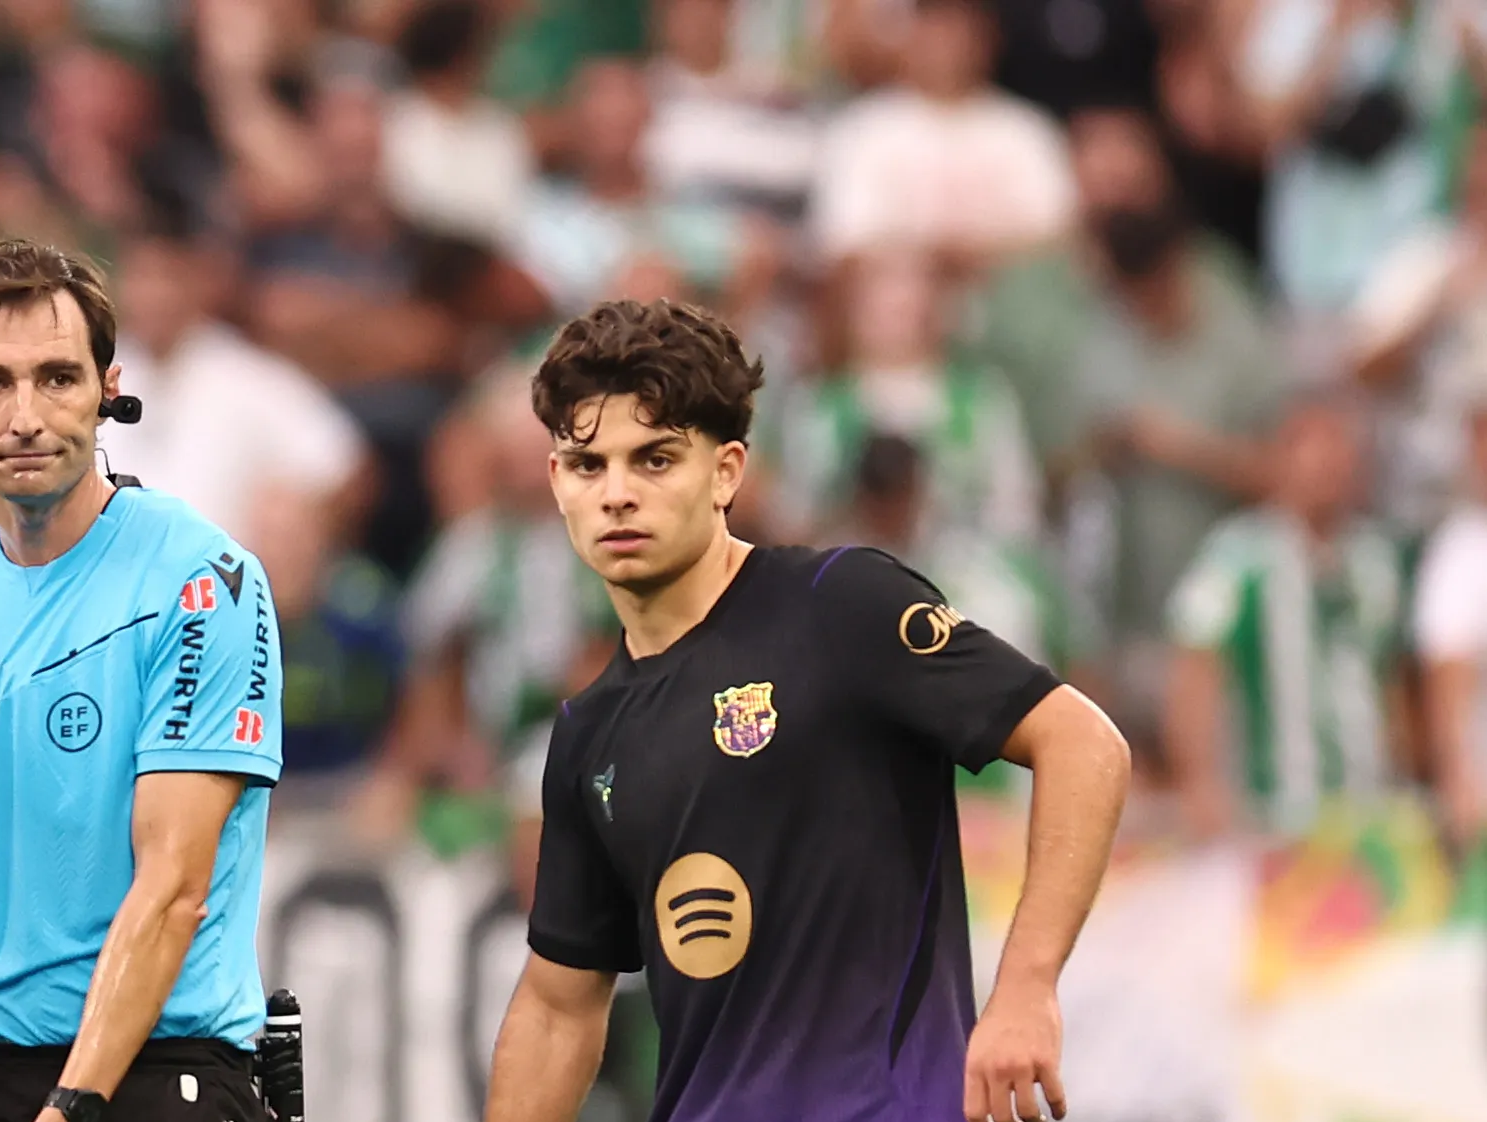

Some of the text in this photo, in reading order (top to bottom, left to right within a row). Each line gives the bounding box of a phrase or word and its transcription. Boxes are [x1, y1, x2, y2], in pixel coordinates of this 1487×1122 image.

[246, 578, 269, 701] WÜRTH
[60, 706, 88, 721] RF
[163, 618, 206, 741] WÜRTH
[60, 723, 89, 738] EF
